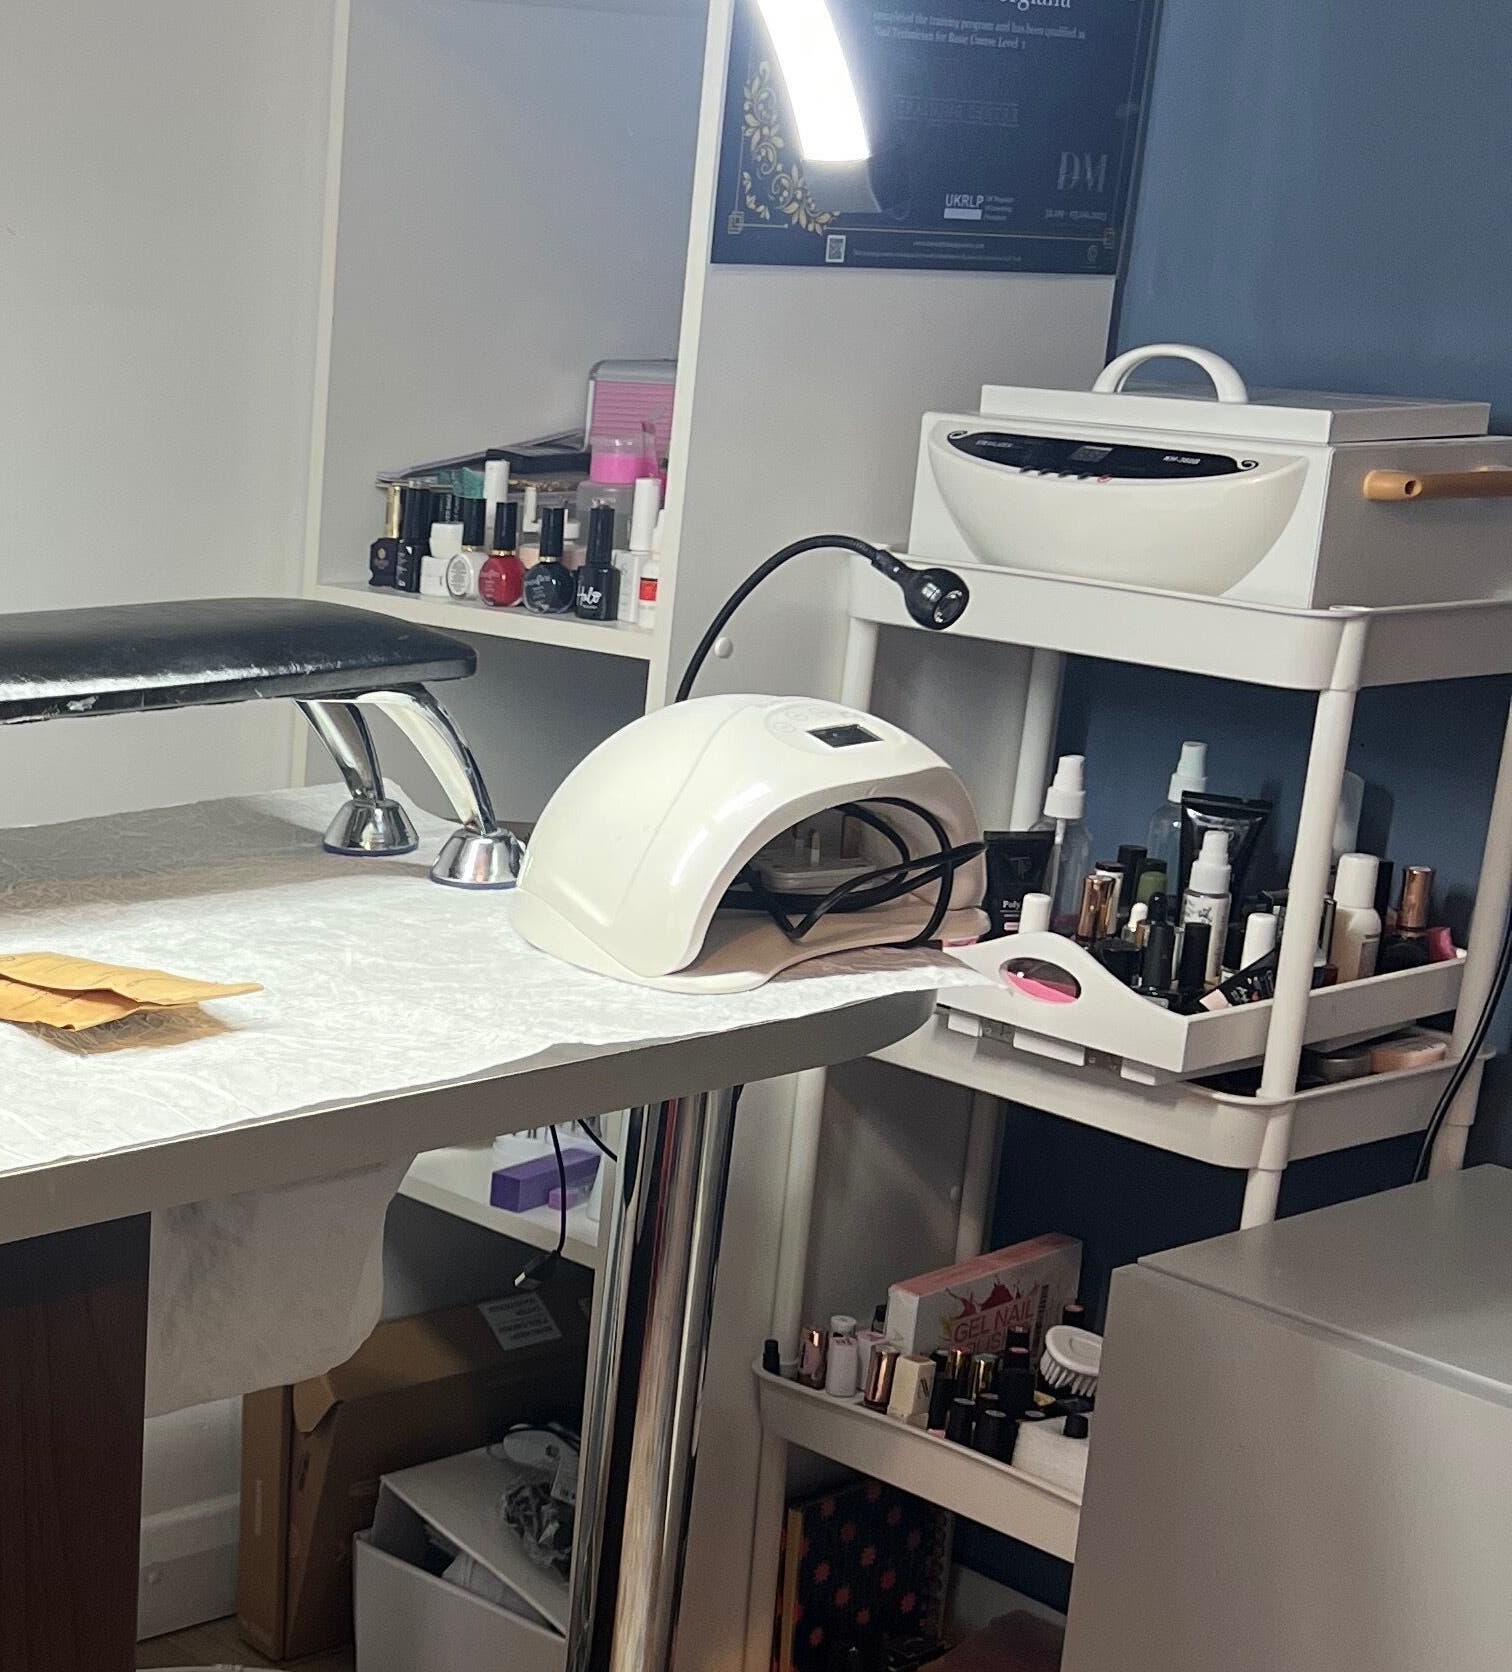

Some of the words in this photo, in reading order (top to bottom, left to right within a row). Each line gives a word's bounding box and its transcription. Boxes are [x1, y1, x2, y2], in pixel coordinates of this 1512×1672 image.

[998, 36, 1019, 49] Level
[945, 193, 984, 208] UKRLP
[955, 1315, 991, 1343] GEL
[995, 1300, 1034, 1329] NAIL
